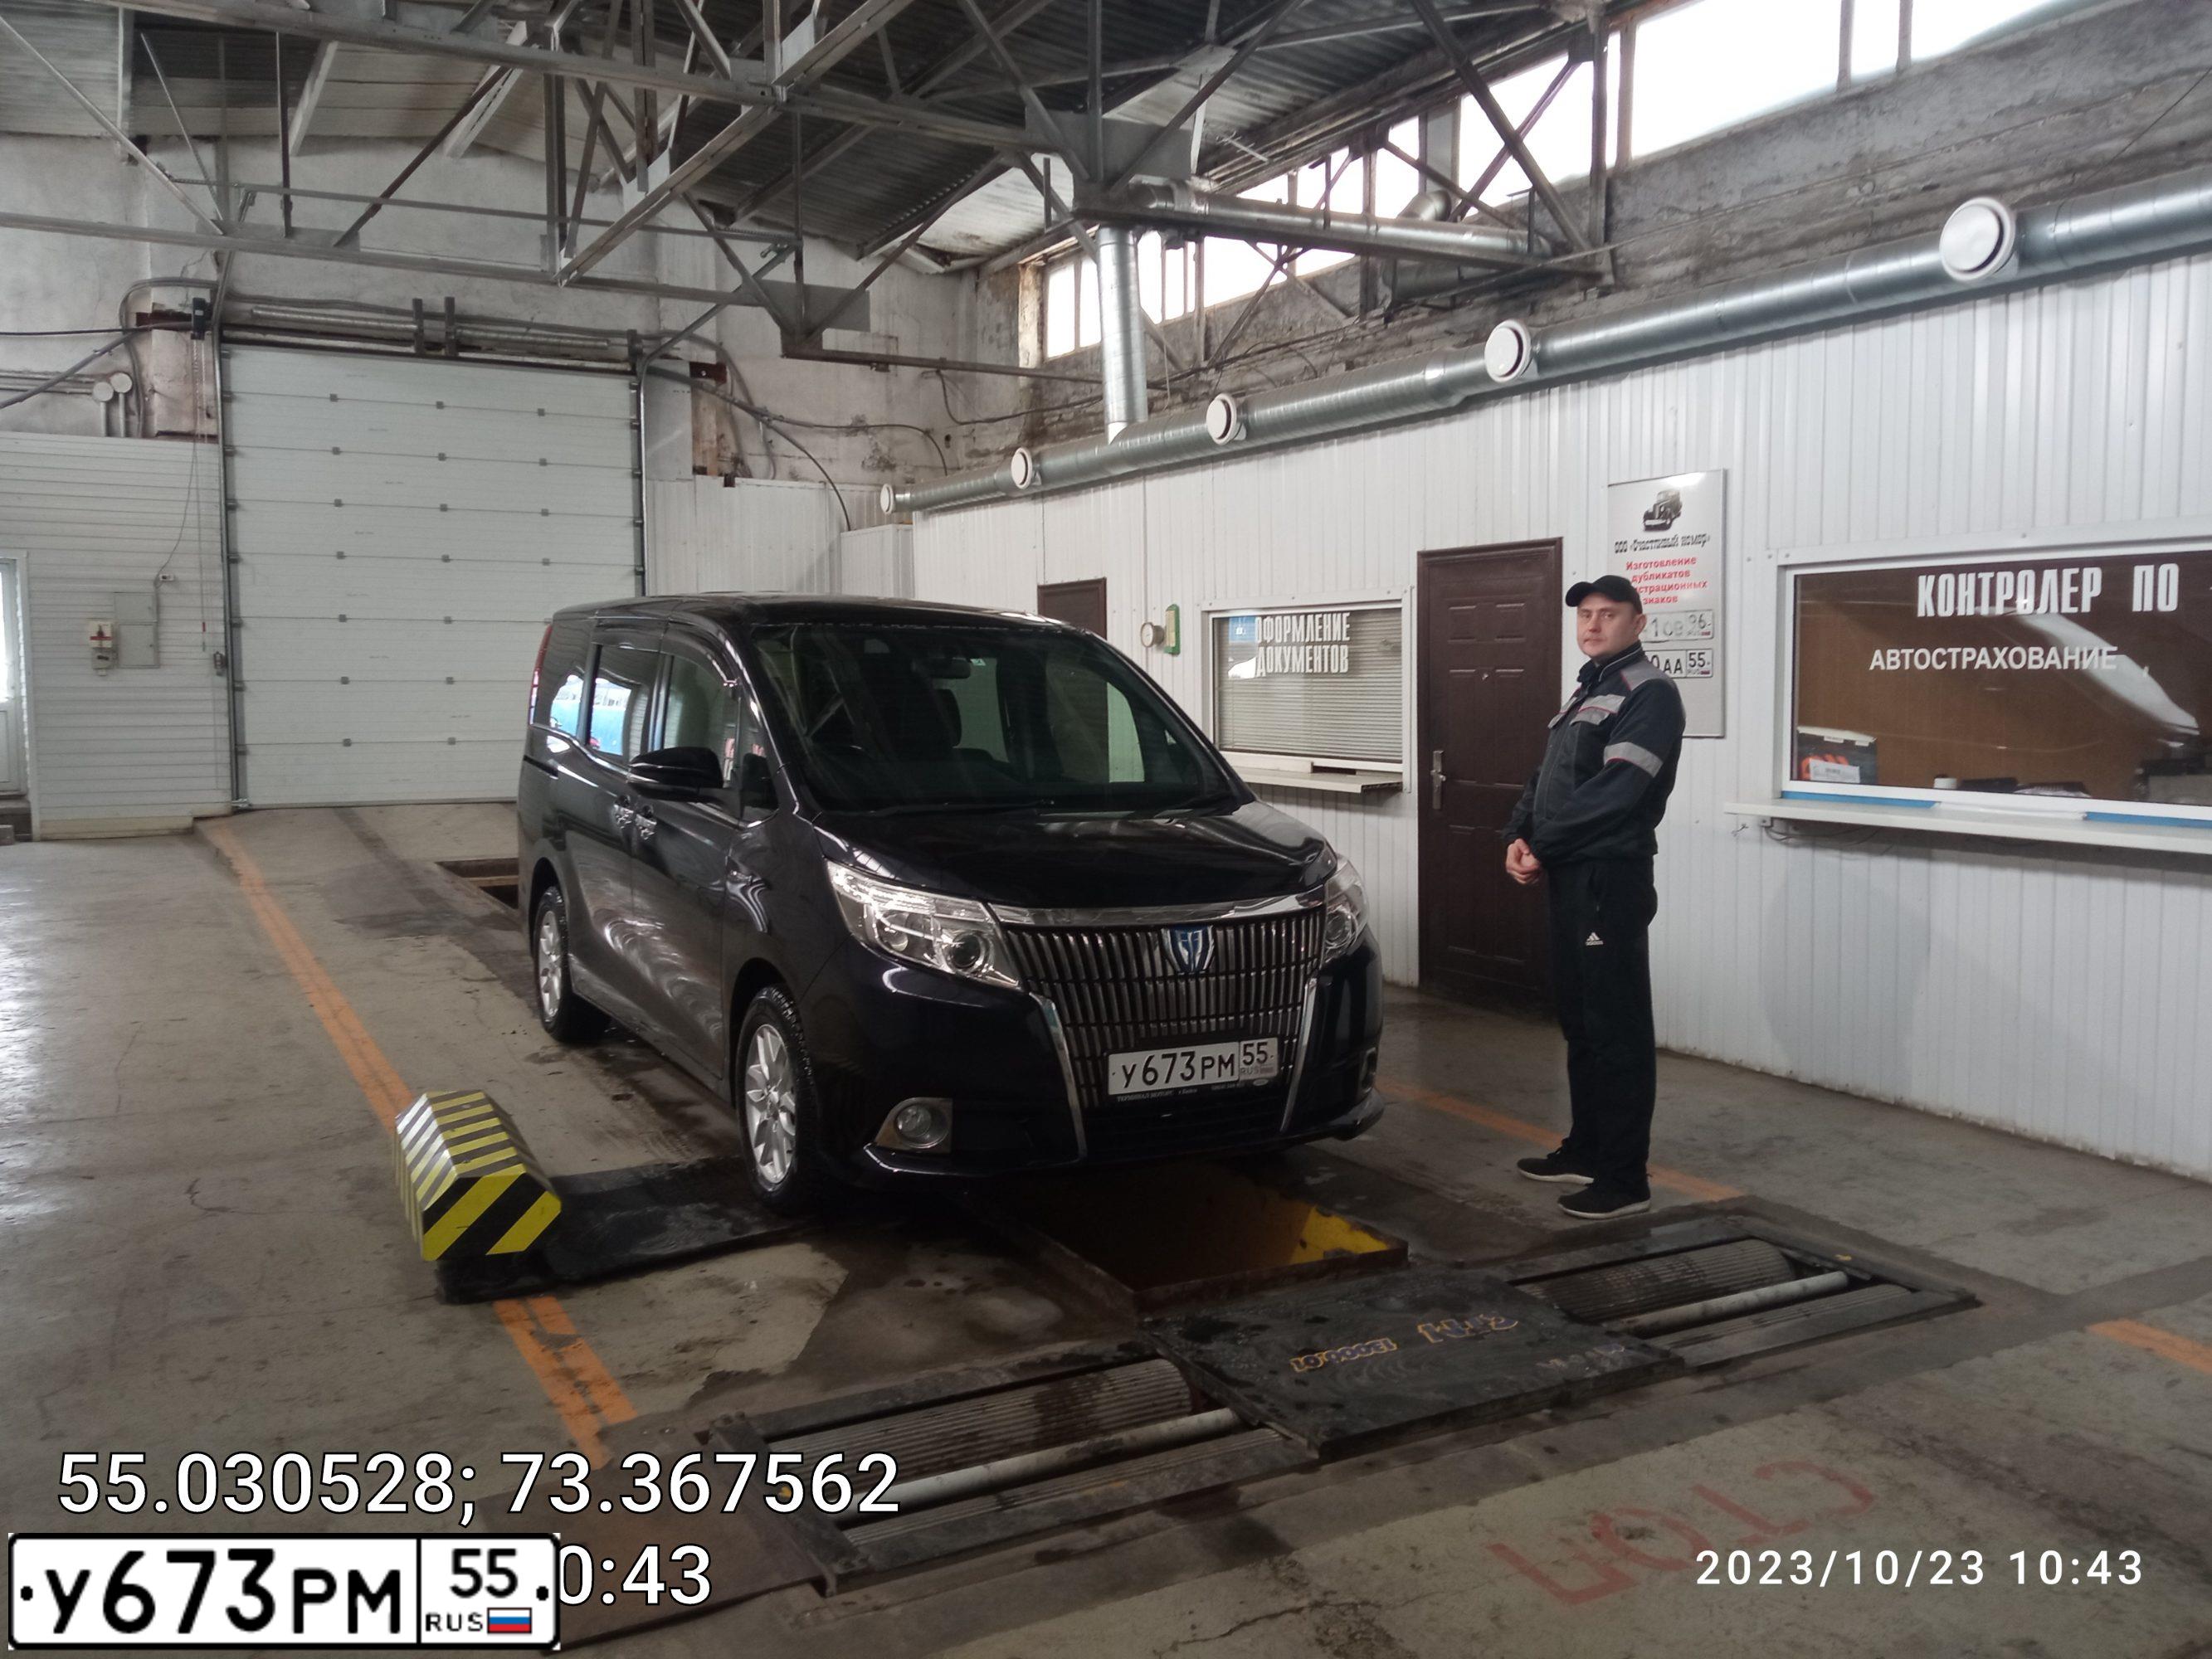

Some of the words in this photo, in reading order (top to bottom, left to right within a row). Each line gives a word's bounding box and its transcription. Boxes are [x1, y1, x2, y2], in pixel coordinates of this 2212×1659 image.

[1625, 556, 1697, 571] Изготовление
[1630, 568, 1691, 583] дубликатов
[1642, 595, 1678, 605] знаков
[1917, 566, 2102, 617] КОНТРОЛЕР
[2132, 562, 2180, 612] ПО
[1255, 612, 1351, 644] ОФОРМЛЕНИЕ
[1255, 644, 1350, 678] ДОКУМЕНТОВ
[1688, 651, 1706, 668] 55
[1869, 645, 2118, 671] АВТОСТРАХОВАНИЕ
[1121, 1050, 1235, 1089] У673РМ
[1241, 1041, 1269, 1067] 55
